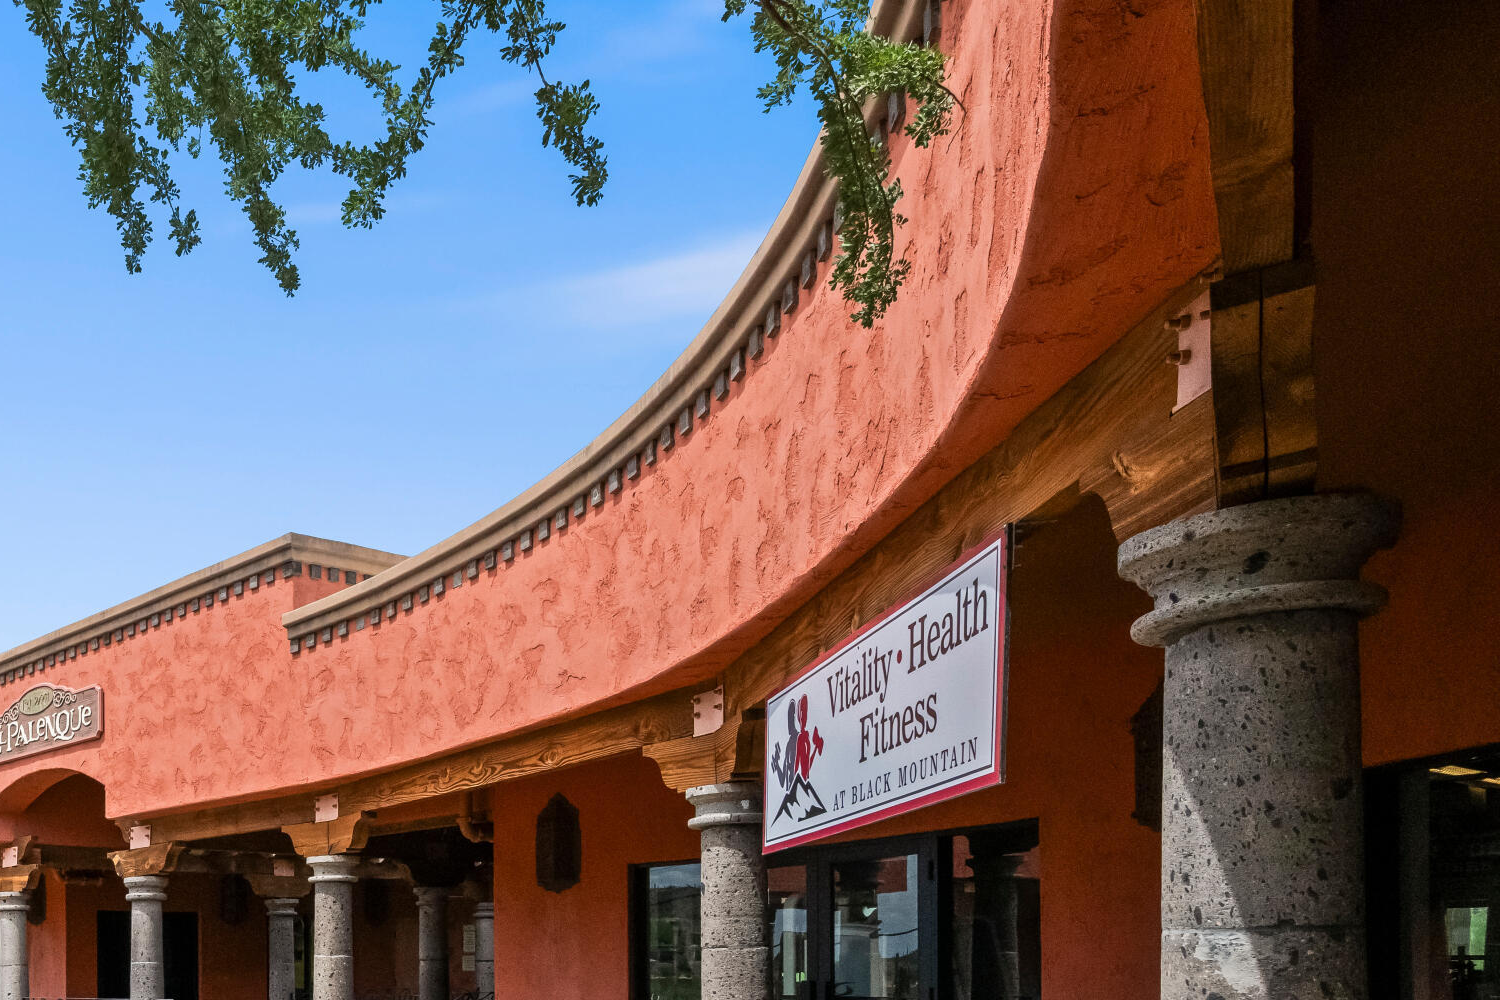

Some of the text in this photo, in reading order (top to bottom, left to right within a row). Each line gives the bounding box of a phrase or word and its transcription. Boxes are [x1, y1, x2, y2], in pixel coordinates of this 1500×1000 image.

[827, 577, 989, 718] Vitality Health
[859, 693, 938, 763] Fitness
[833, 737, 978, 812] AT BLACK MOUNTAIN
